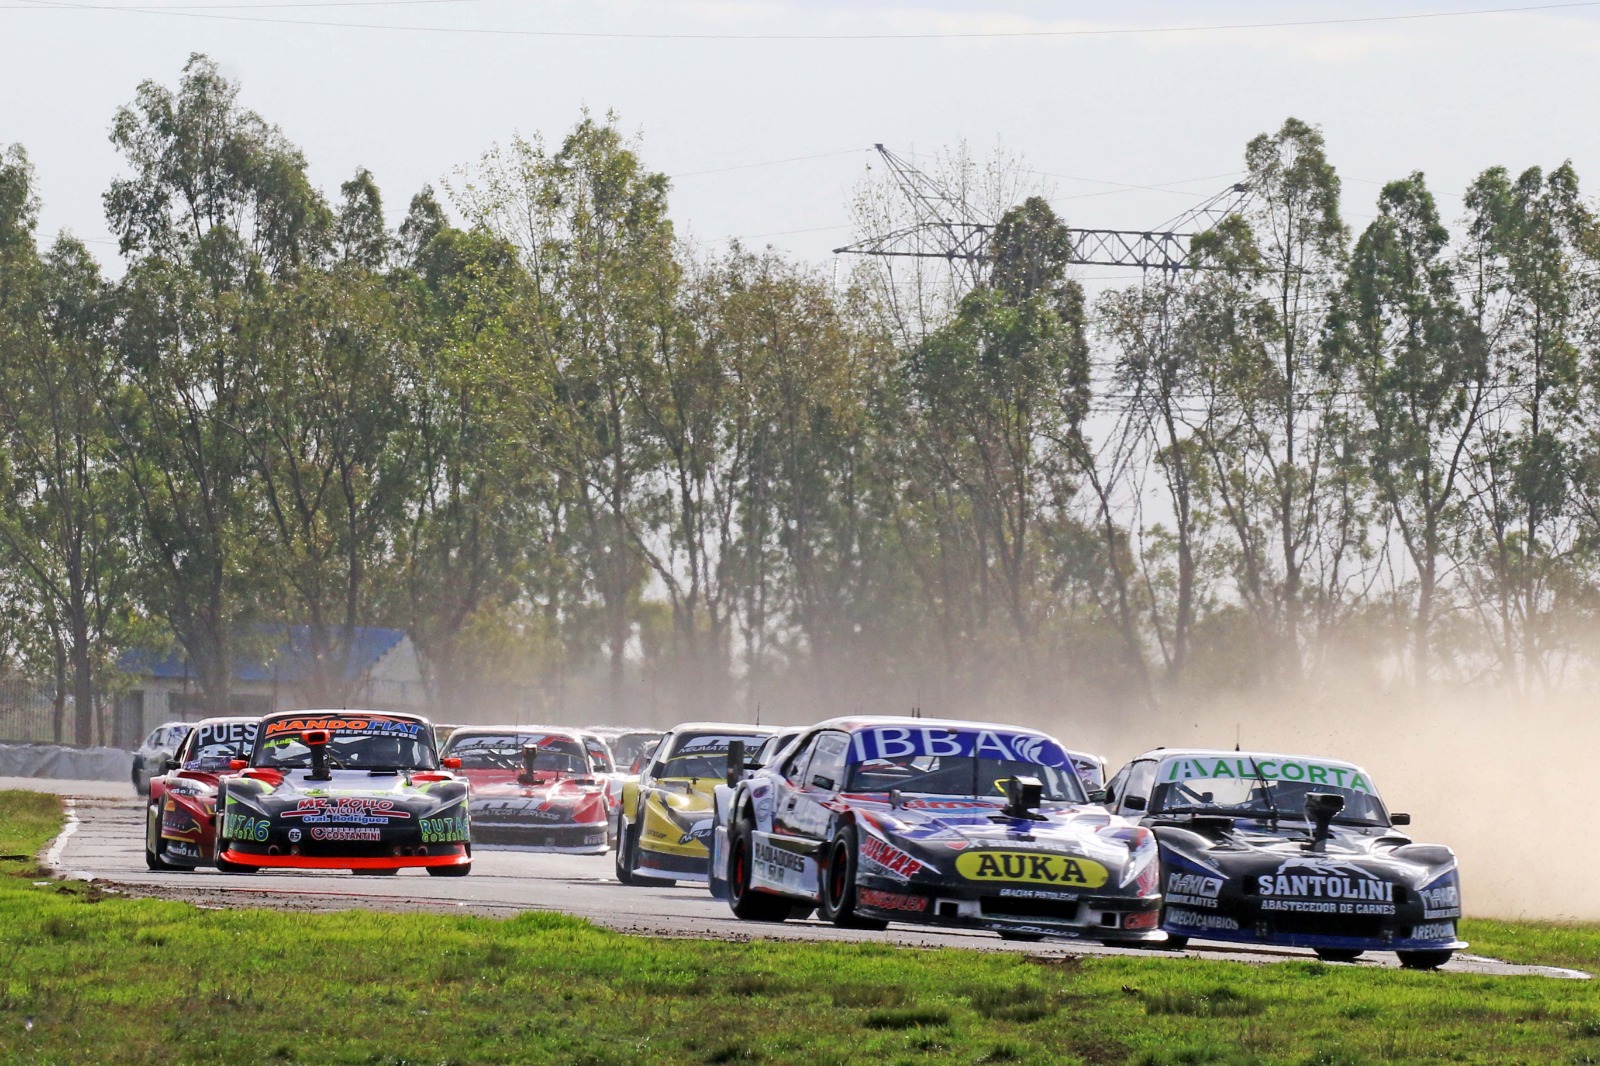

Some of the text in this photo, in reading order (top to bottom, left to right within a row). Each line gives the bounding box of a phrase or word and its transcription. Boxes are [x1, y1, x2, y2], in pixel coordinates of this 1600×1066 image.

[335, 729, 418, 740] REPUESTOS
[1212, 759, 1370, 794] ALCORTA
[297, 797, 394, 811] MR. POLLO
[326, 832, 381, 841] COSTANTINI
[755, 843, 805, 873] RADIADORES
[976, 853, 1088, 883] AUKA
[1258, 875, 1393, 901] SANTOLINI
[1261, 900, 1396, 915] ABASTECEDOR DE CARNES
